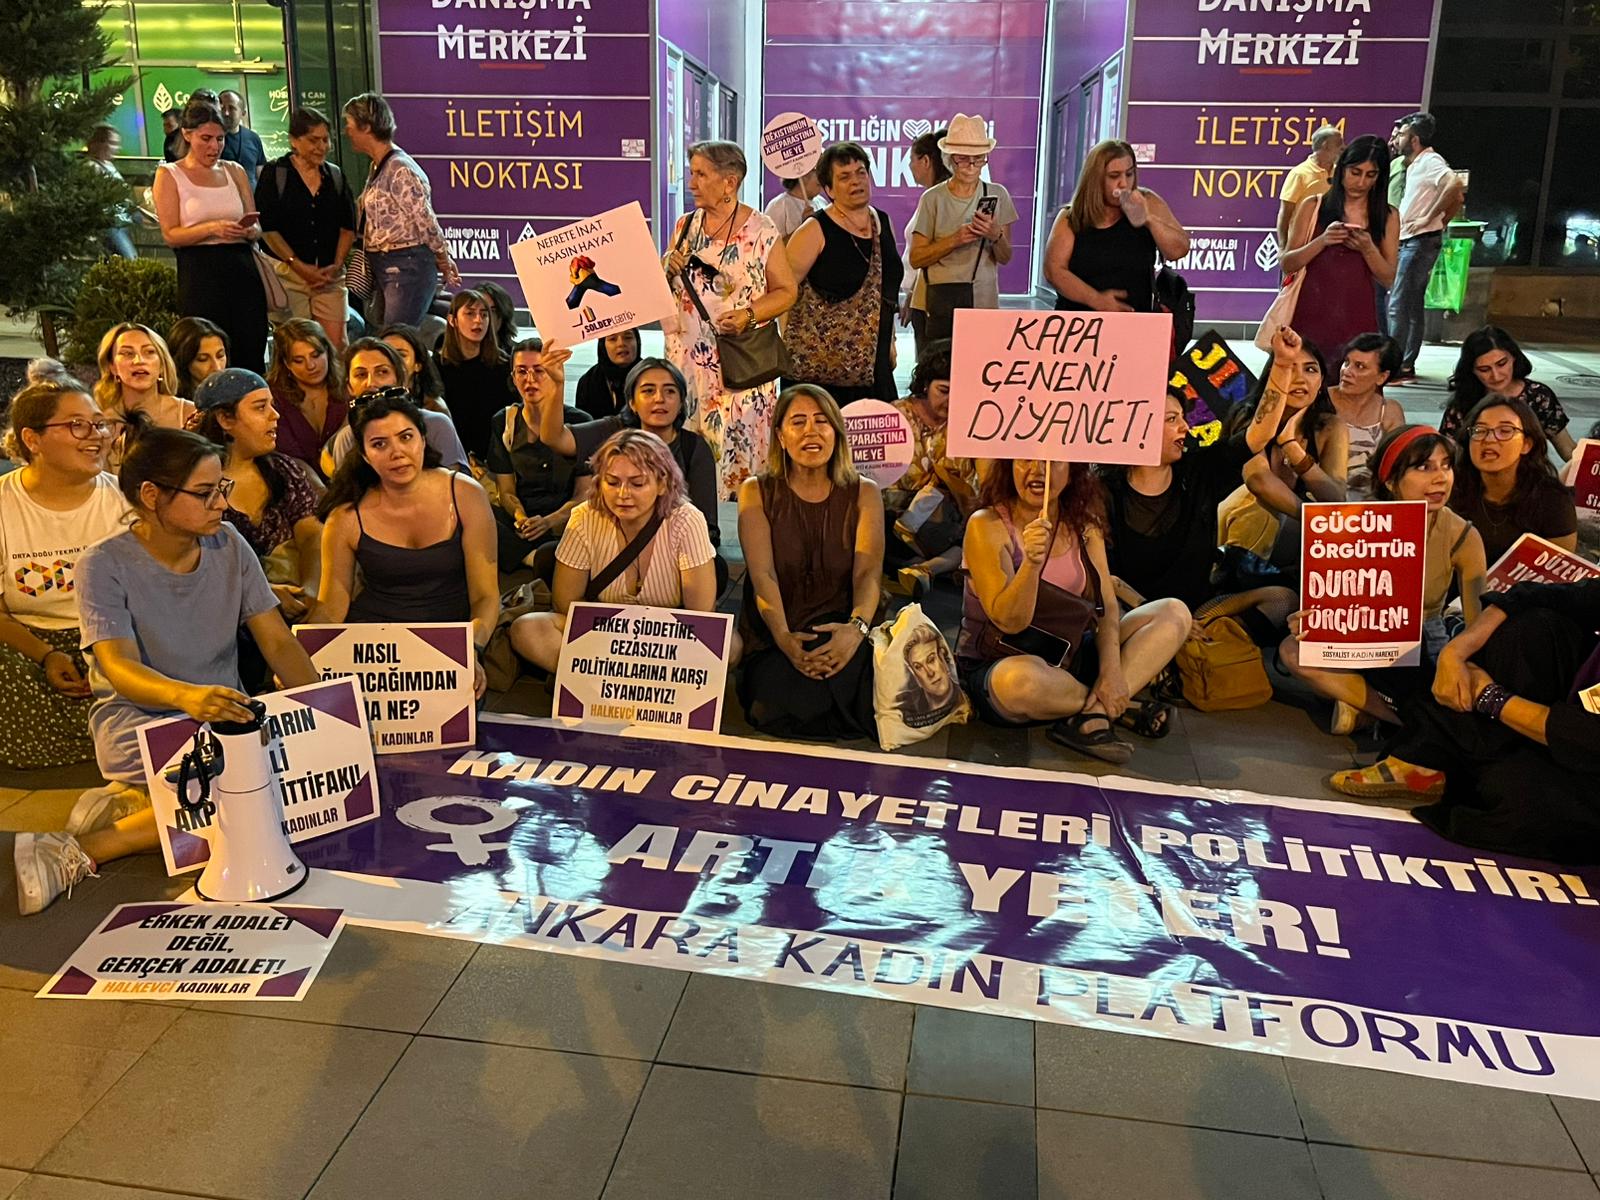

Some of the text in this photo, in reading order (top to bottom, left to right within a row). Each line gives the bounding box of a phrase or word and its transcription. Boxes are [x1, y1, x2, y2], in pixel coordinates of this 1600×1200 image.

[437, 15, 587, 60] MERKEZİ
[1198, 18, 1363, 65] MERKEZİ
[445, 101, 583, 147] İLETİŞİM
[783, 149, 794, 160] ME
[793, 145, 804, 156] YE
[450, 161, 583, 190] NOKTASI
[1193, 169, 1284, 198] NOKT
[447, 240, 500, 260] NKAYA
[536, 232, 615, 266] YAŞASIN HAYAT
[537, 229, 577, 250] NEFRETE
[1006, 315, 1104, 357] KAPA
[981, 354, 1118, 393] ÇENENİ
[967, 395, 1154, 450] DİYANET!
[853, 448, 884, 461] ME YE
[1309, 510, 1392, 534] GÜCÜN
[12, 552, 31, 560] ORTA
[32, 549, 53, 558] DOĞU
[1309, 538, 1416, 559] ÖRGÜTTÜR
[1308, 567, 1393, 599] DURMA
[592, 616, 630, 634] ERKEK
[1308, 603, 1409, 635] ÖRGÜTLEN!
[353, 643, 401, 664] NASIL
[610, 639, 678, 661] CEZASIZLIK
[571, 656, 708, 690] POLİTİKALARINA KARŞI
[600, 680, 676, 705] İSYANDAYIZ!
[387, 699, 420, 720] NE?
[590, 703, 683, 725] HALKEVCİ KADINLAR
[381, 730, 434, 746] KADINLAR
[280, 807, 339, 836] KADINLAR
[446, 749, 1600, 906] KADIN CİNAYETLERİ POLİTİKTİR!
[138, 914, 299, 931] ERKEK ADALET
[165, 932, 235, 953] DEĞİL,
[96, 956, 287, 979] GERÇEK ADALET!
[101, 980, 251, 994] HALKEVCİ KADINLAR
[776, 932, 1004, 1000] KADIN
[1037, 968, 1556, 1076] PLATFORMU
